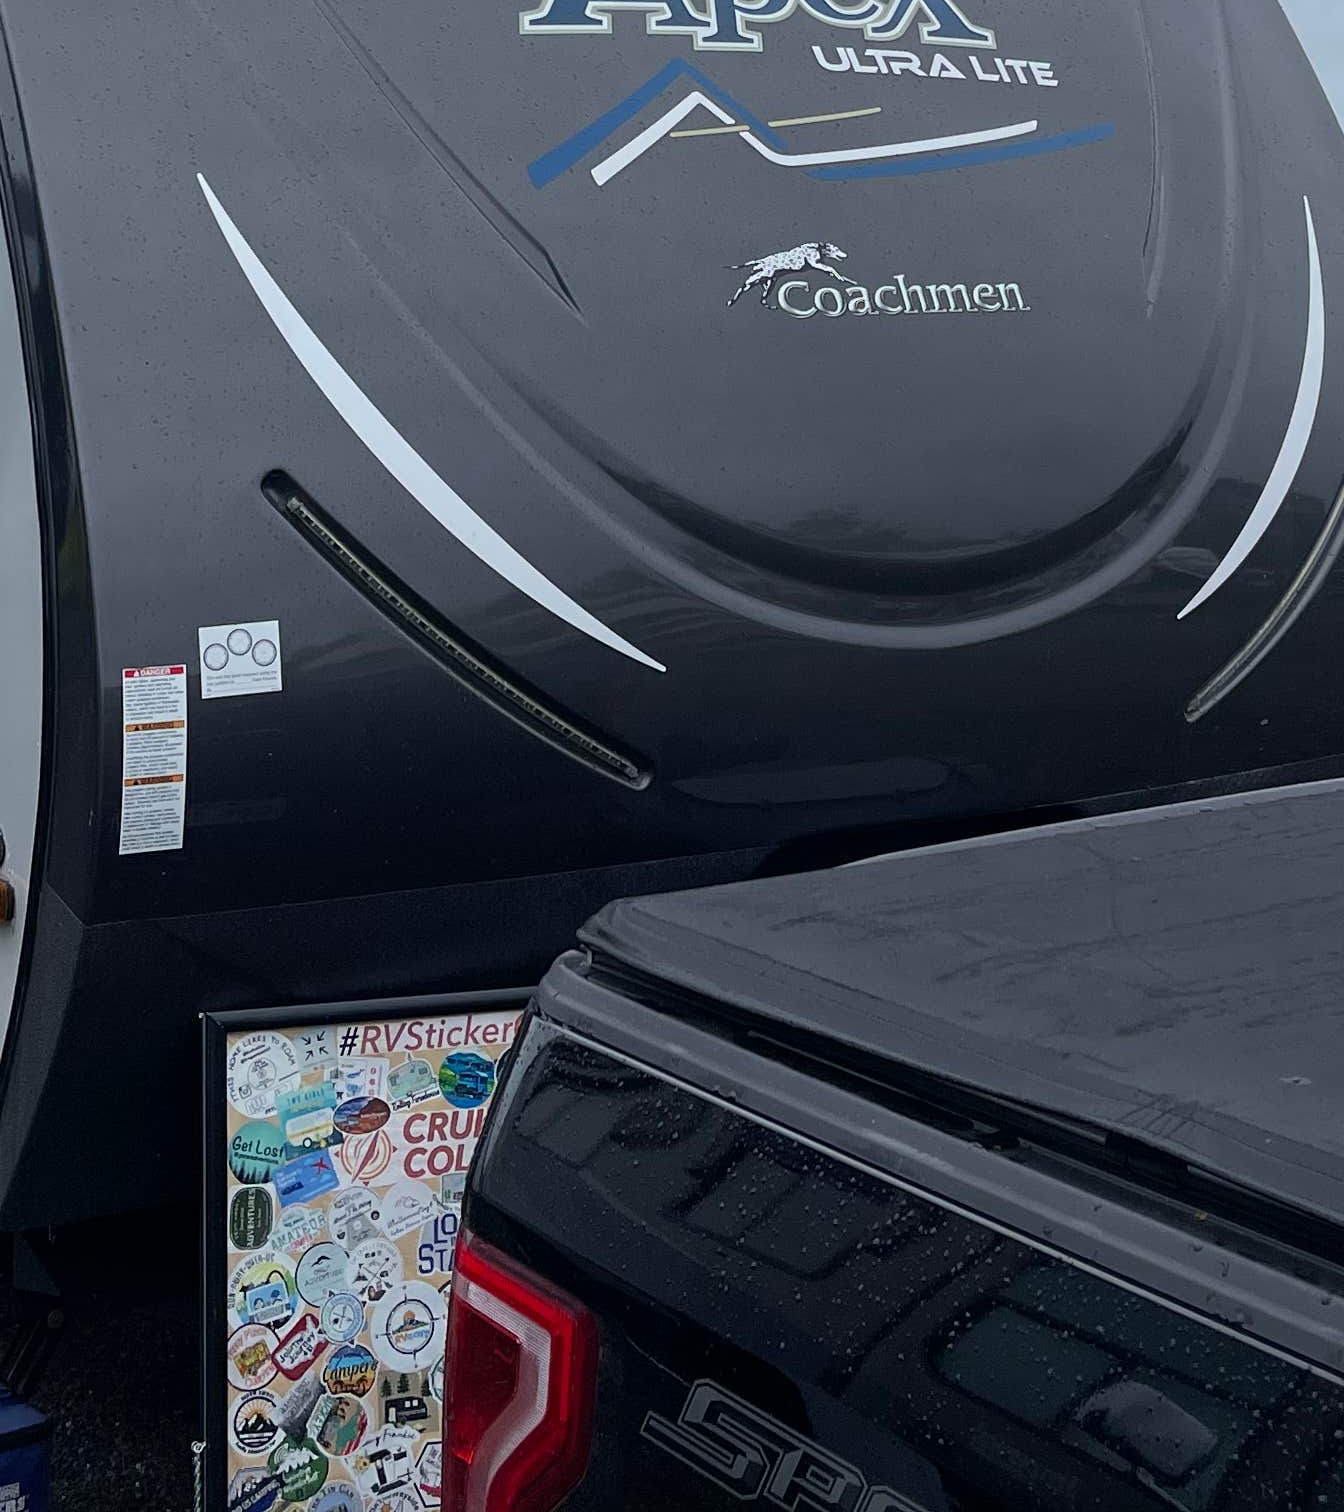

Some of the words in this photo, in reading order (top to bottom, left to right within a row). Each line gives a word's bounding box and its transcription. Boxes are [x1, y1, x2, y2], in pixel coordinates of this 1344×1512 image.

[812, 46, 967, 81] ULTRA
[969, 52, 1059, 87] LITE
[776, 274, 1031, 320] Coachmen
[232, 1135, 253, 1152] Get
[255, 1139, 284, 1158] Lost
